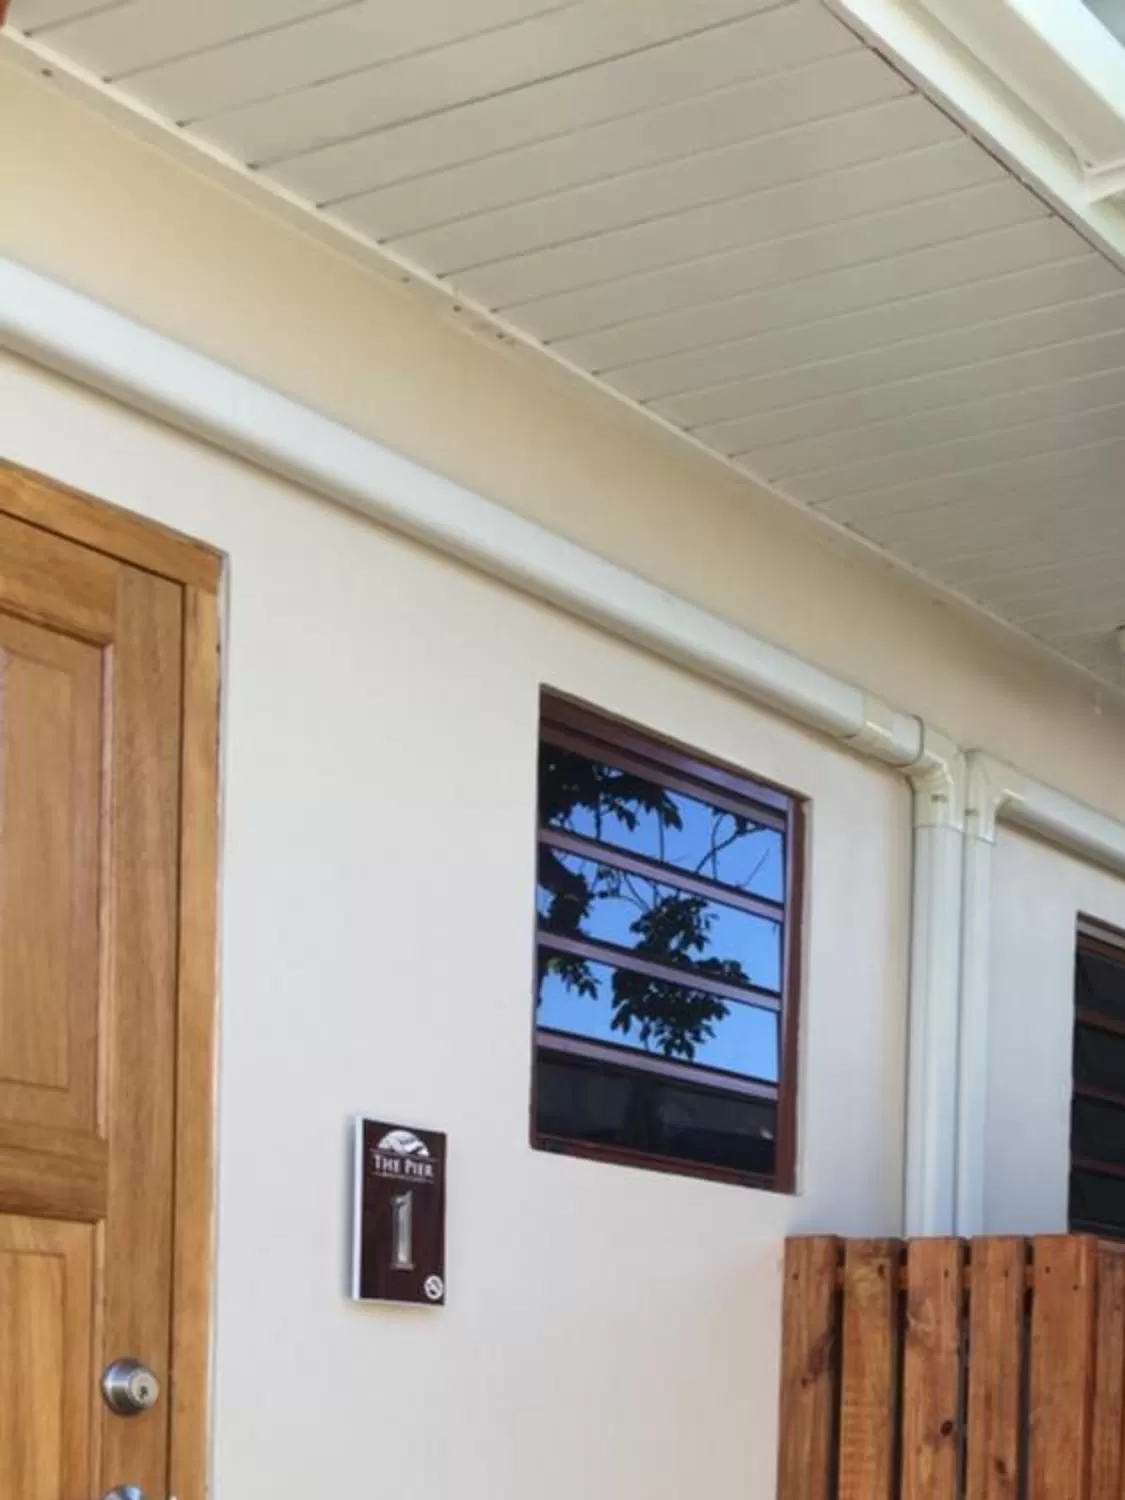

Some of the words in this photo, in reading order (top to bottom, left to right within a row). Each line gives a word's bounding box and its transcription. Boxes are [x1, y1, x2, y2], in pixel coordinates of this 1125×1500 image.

[373, 1154, 401, 1173] THE
[404, 1158, 434, 1178] PIER
[391, 1190, 414, 1270] 1
